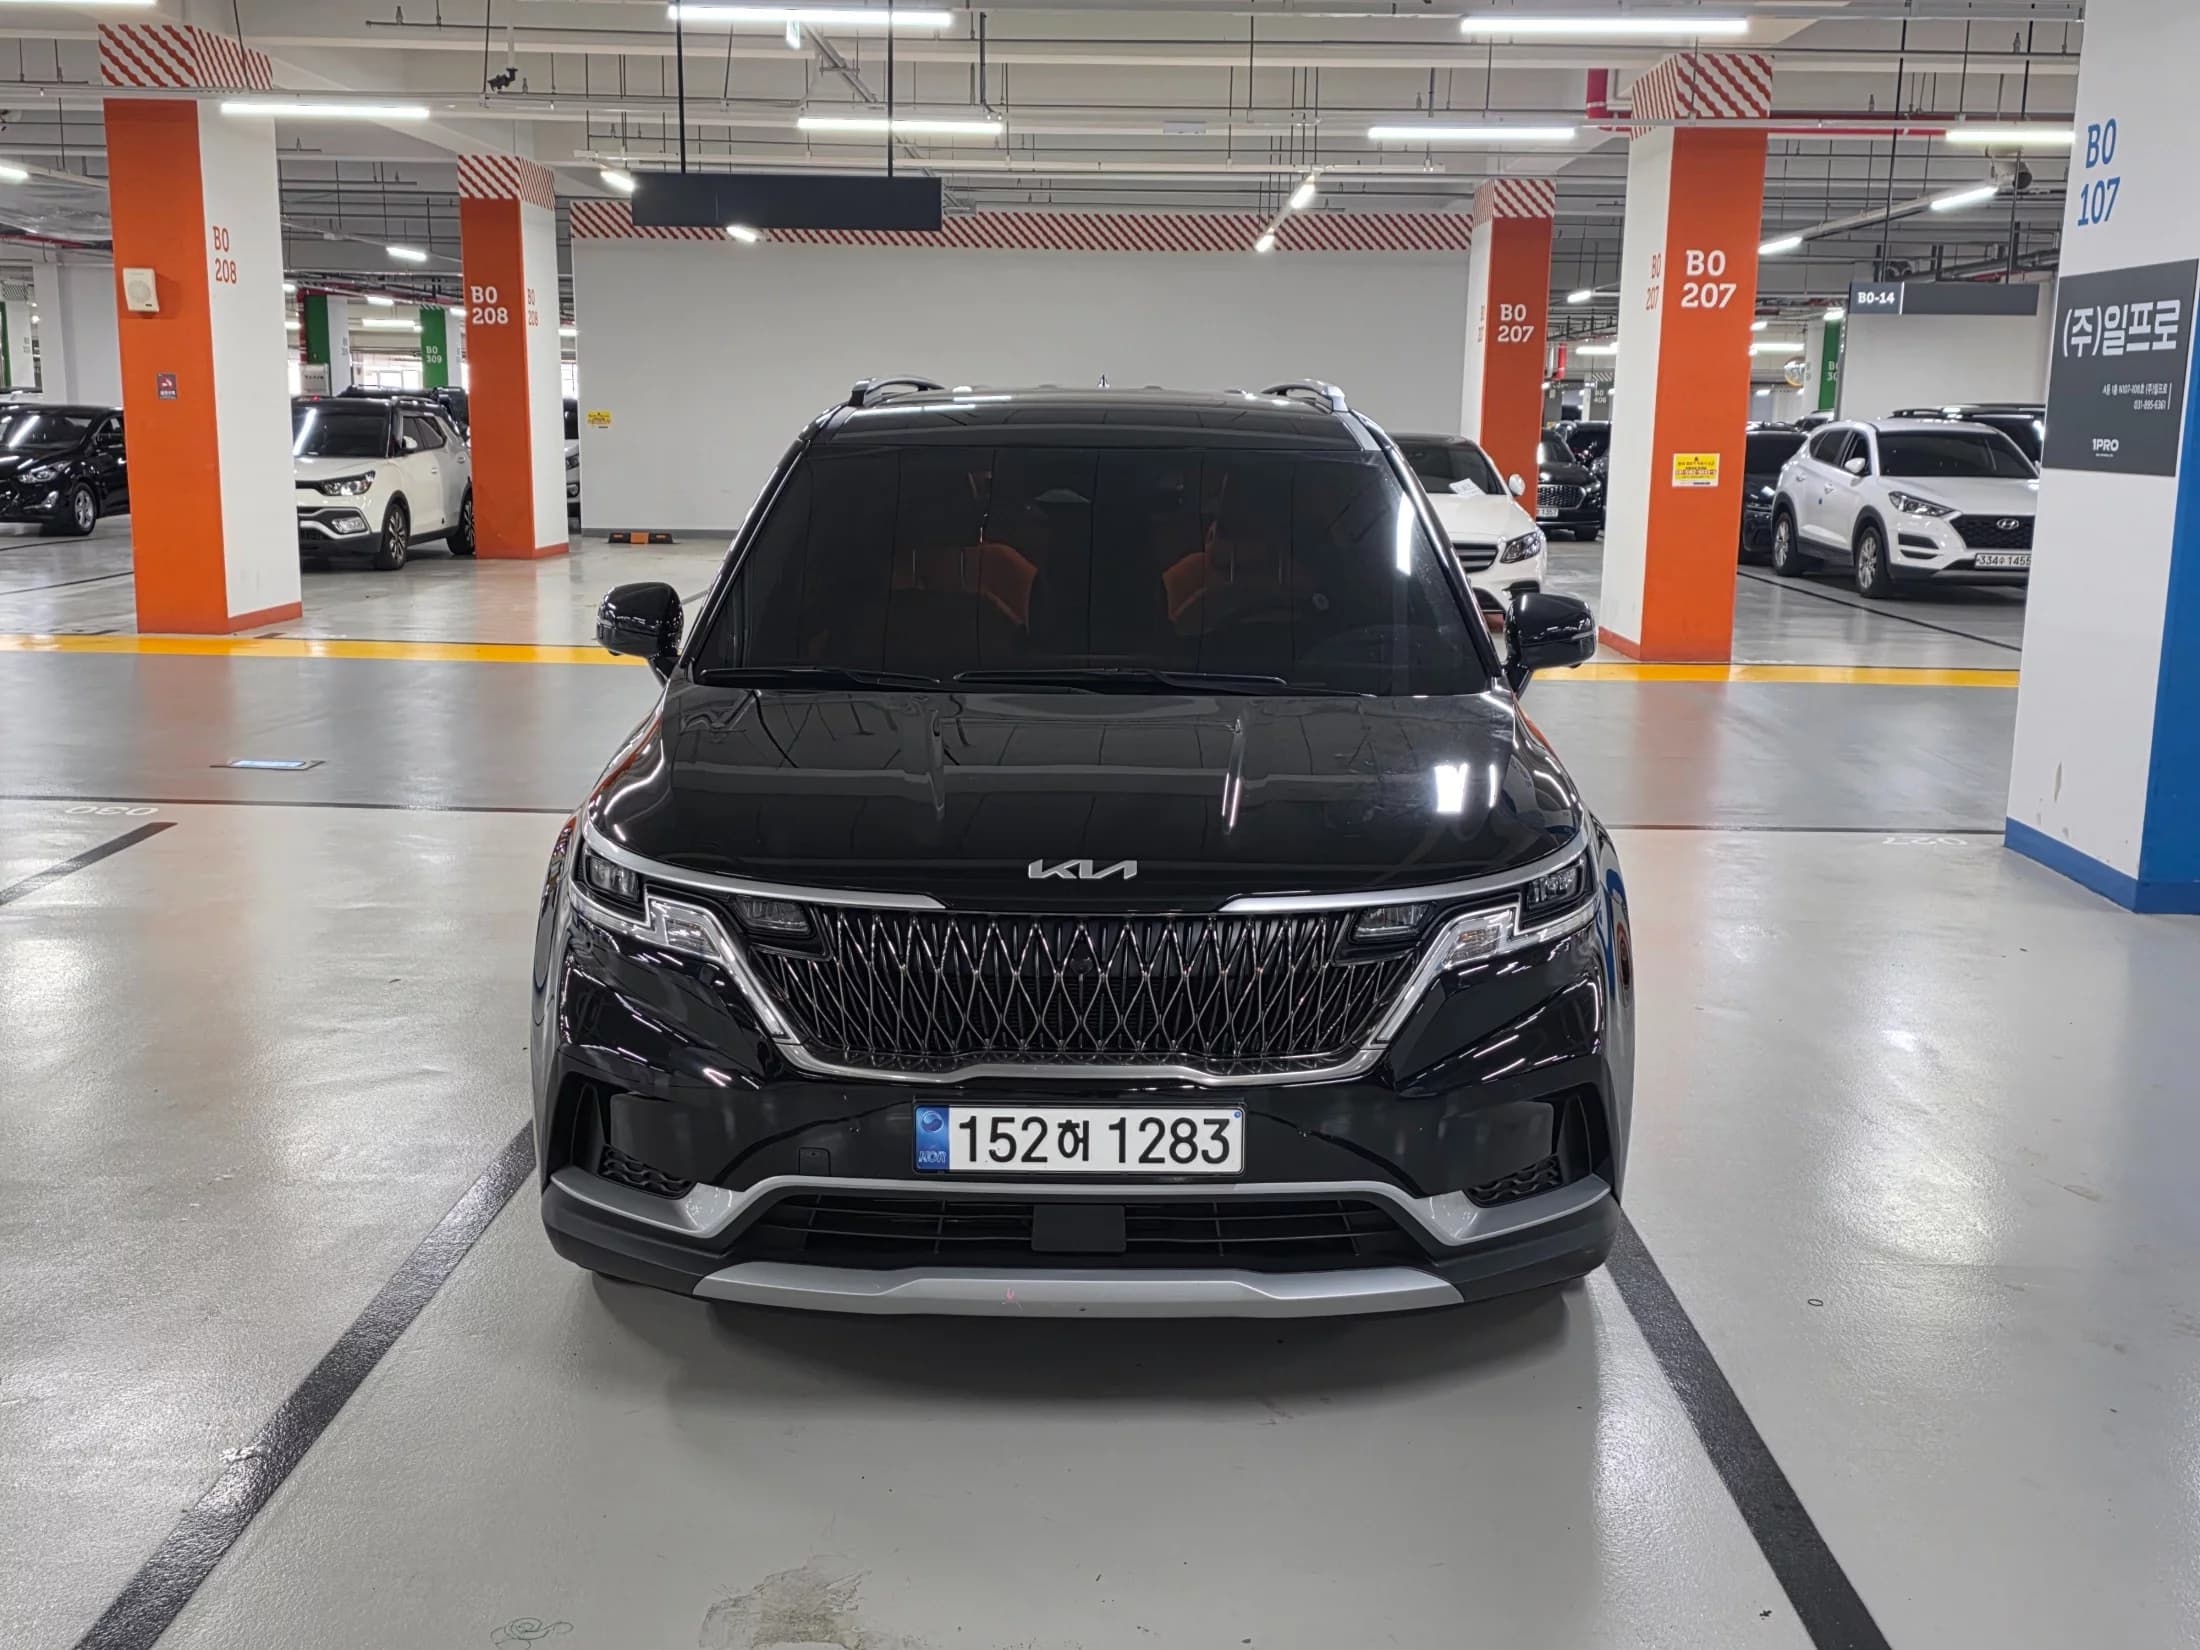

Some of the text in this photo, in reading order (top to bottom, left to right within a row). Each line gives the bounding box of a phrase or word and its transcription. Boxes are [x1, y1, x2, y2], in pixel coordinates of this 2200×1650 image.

[2086, 118, 2116, 168] B0
[2078, 177, 2120, 226] 107
[215, 258, 237, 284] 208
[1685, 249, 1726, 276] B0
[470, 286, 498, 304] B0
[1681, 282, 1737, 308] 207
[1857, 291, 1895, 304] B0-14
[472, 307, 509, 325] 208
[1500, 303, 1527, 321] B0
[1497, 325, 1535, 342] 207
[2063, 299, 2181, 358] (주)일프로
[2093, 438, 2119, 451] 1PRO
[959, 1116, 1230, 1164] 152허 1283
